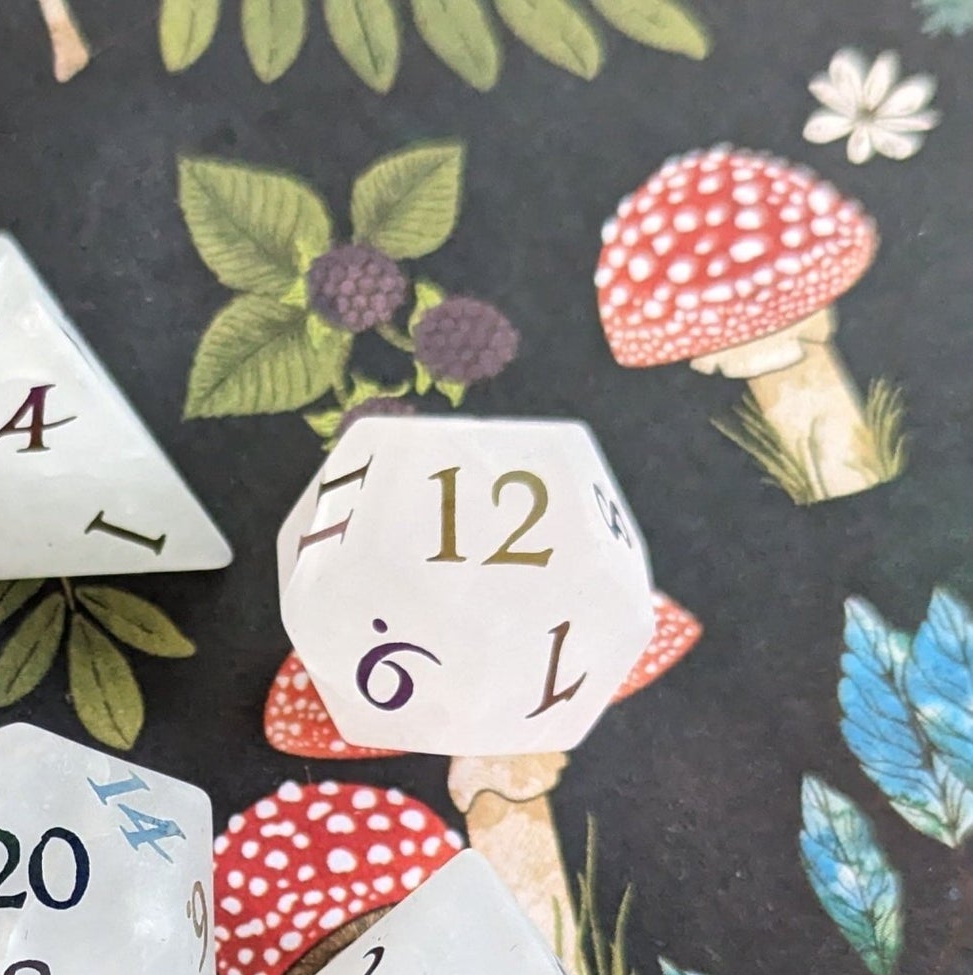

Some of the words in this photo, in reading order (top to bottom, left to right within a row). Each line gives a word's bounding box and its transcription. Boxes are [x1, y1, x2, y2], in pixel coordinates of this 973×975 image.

[85, 510, 166, 555] 1
[296, 454, 373, 563] 11
[425, 466, 553, 567] 12
[87, 771, 186, 863] 14
